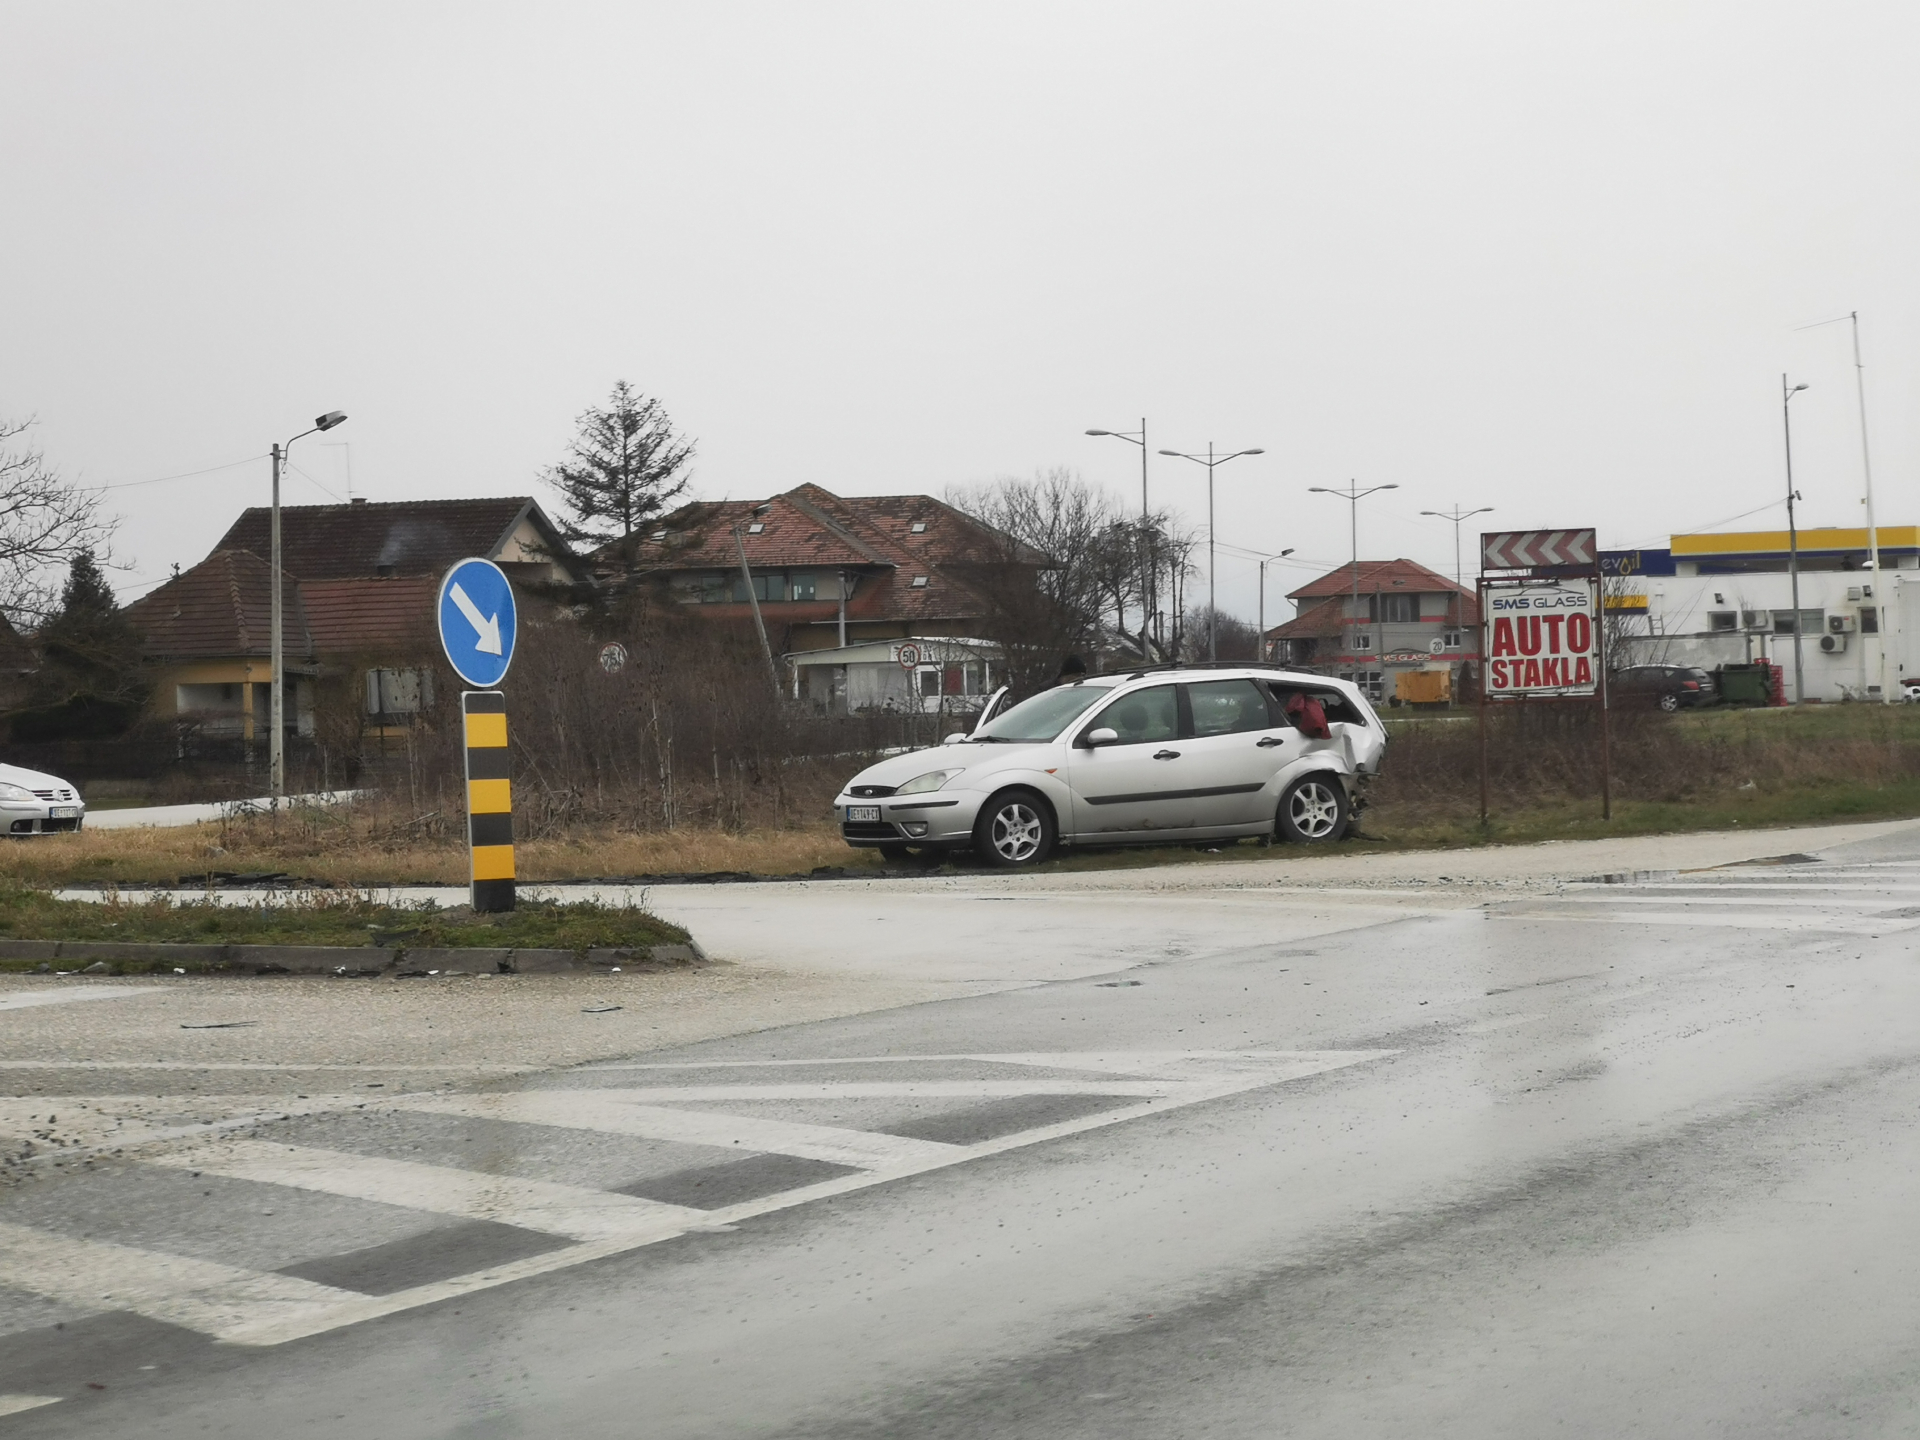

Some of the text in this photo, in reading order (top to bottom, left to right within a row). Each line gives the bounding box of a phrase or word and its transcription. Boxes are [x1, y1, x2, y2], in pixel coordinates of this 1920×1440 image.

[1492, 598, 1530, 610] SMS
[1533, 596, 1588, 608] GLASS
[1491, 612, 1591, 657] AUTO
[1433, 641, 1443, 651] 20
[902, 650, 915, 663] 50
[1398, 653, 1431, 662] GLASS
[1491, 656, 1592, 689] STAKLA
